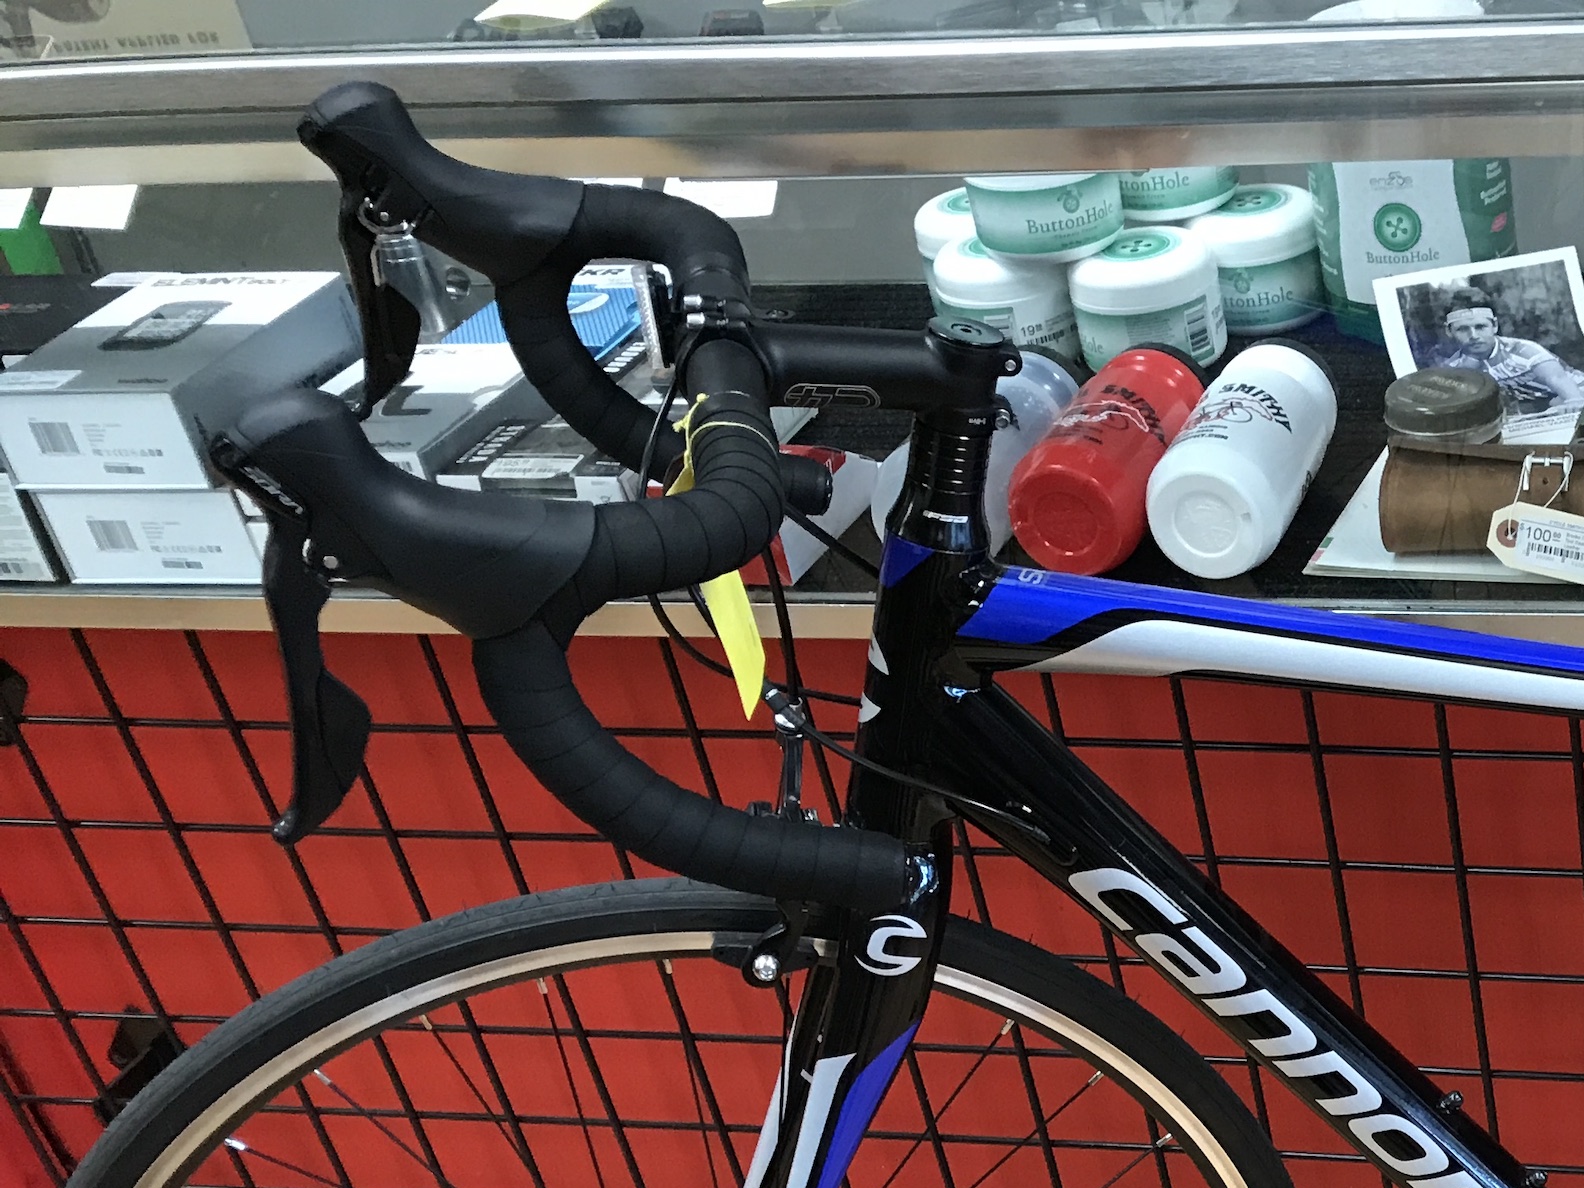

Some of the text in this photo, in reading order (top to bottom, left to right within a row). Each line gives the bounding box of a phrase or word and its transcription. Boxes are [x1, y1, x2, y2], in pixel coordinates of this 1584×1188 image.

[1119, 171, 1190, 193] ttonHole
[1025, 200, 1114, 235] ButtonHole
[1365, 248, 1440, 265] ButtonHole
[1222, 286, 1295, 310] ttonHole
[1218, 383, 1293, 434] SMITHY
